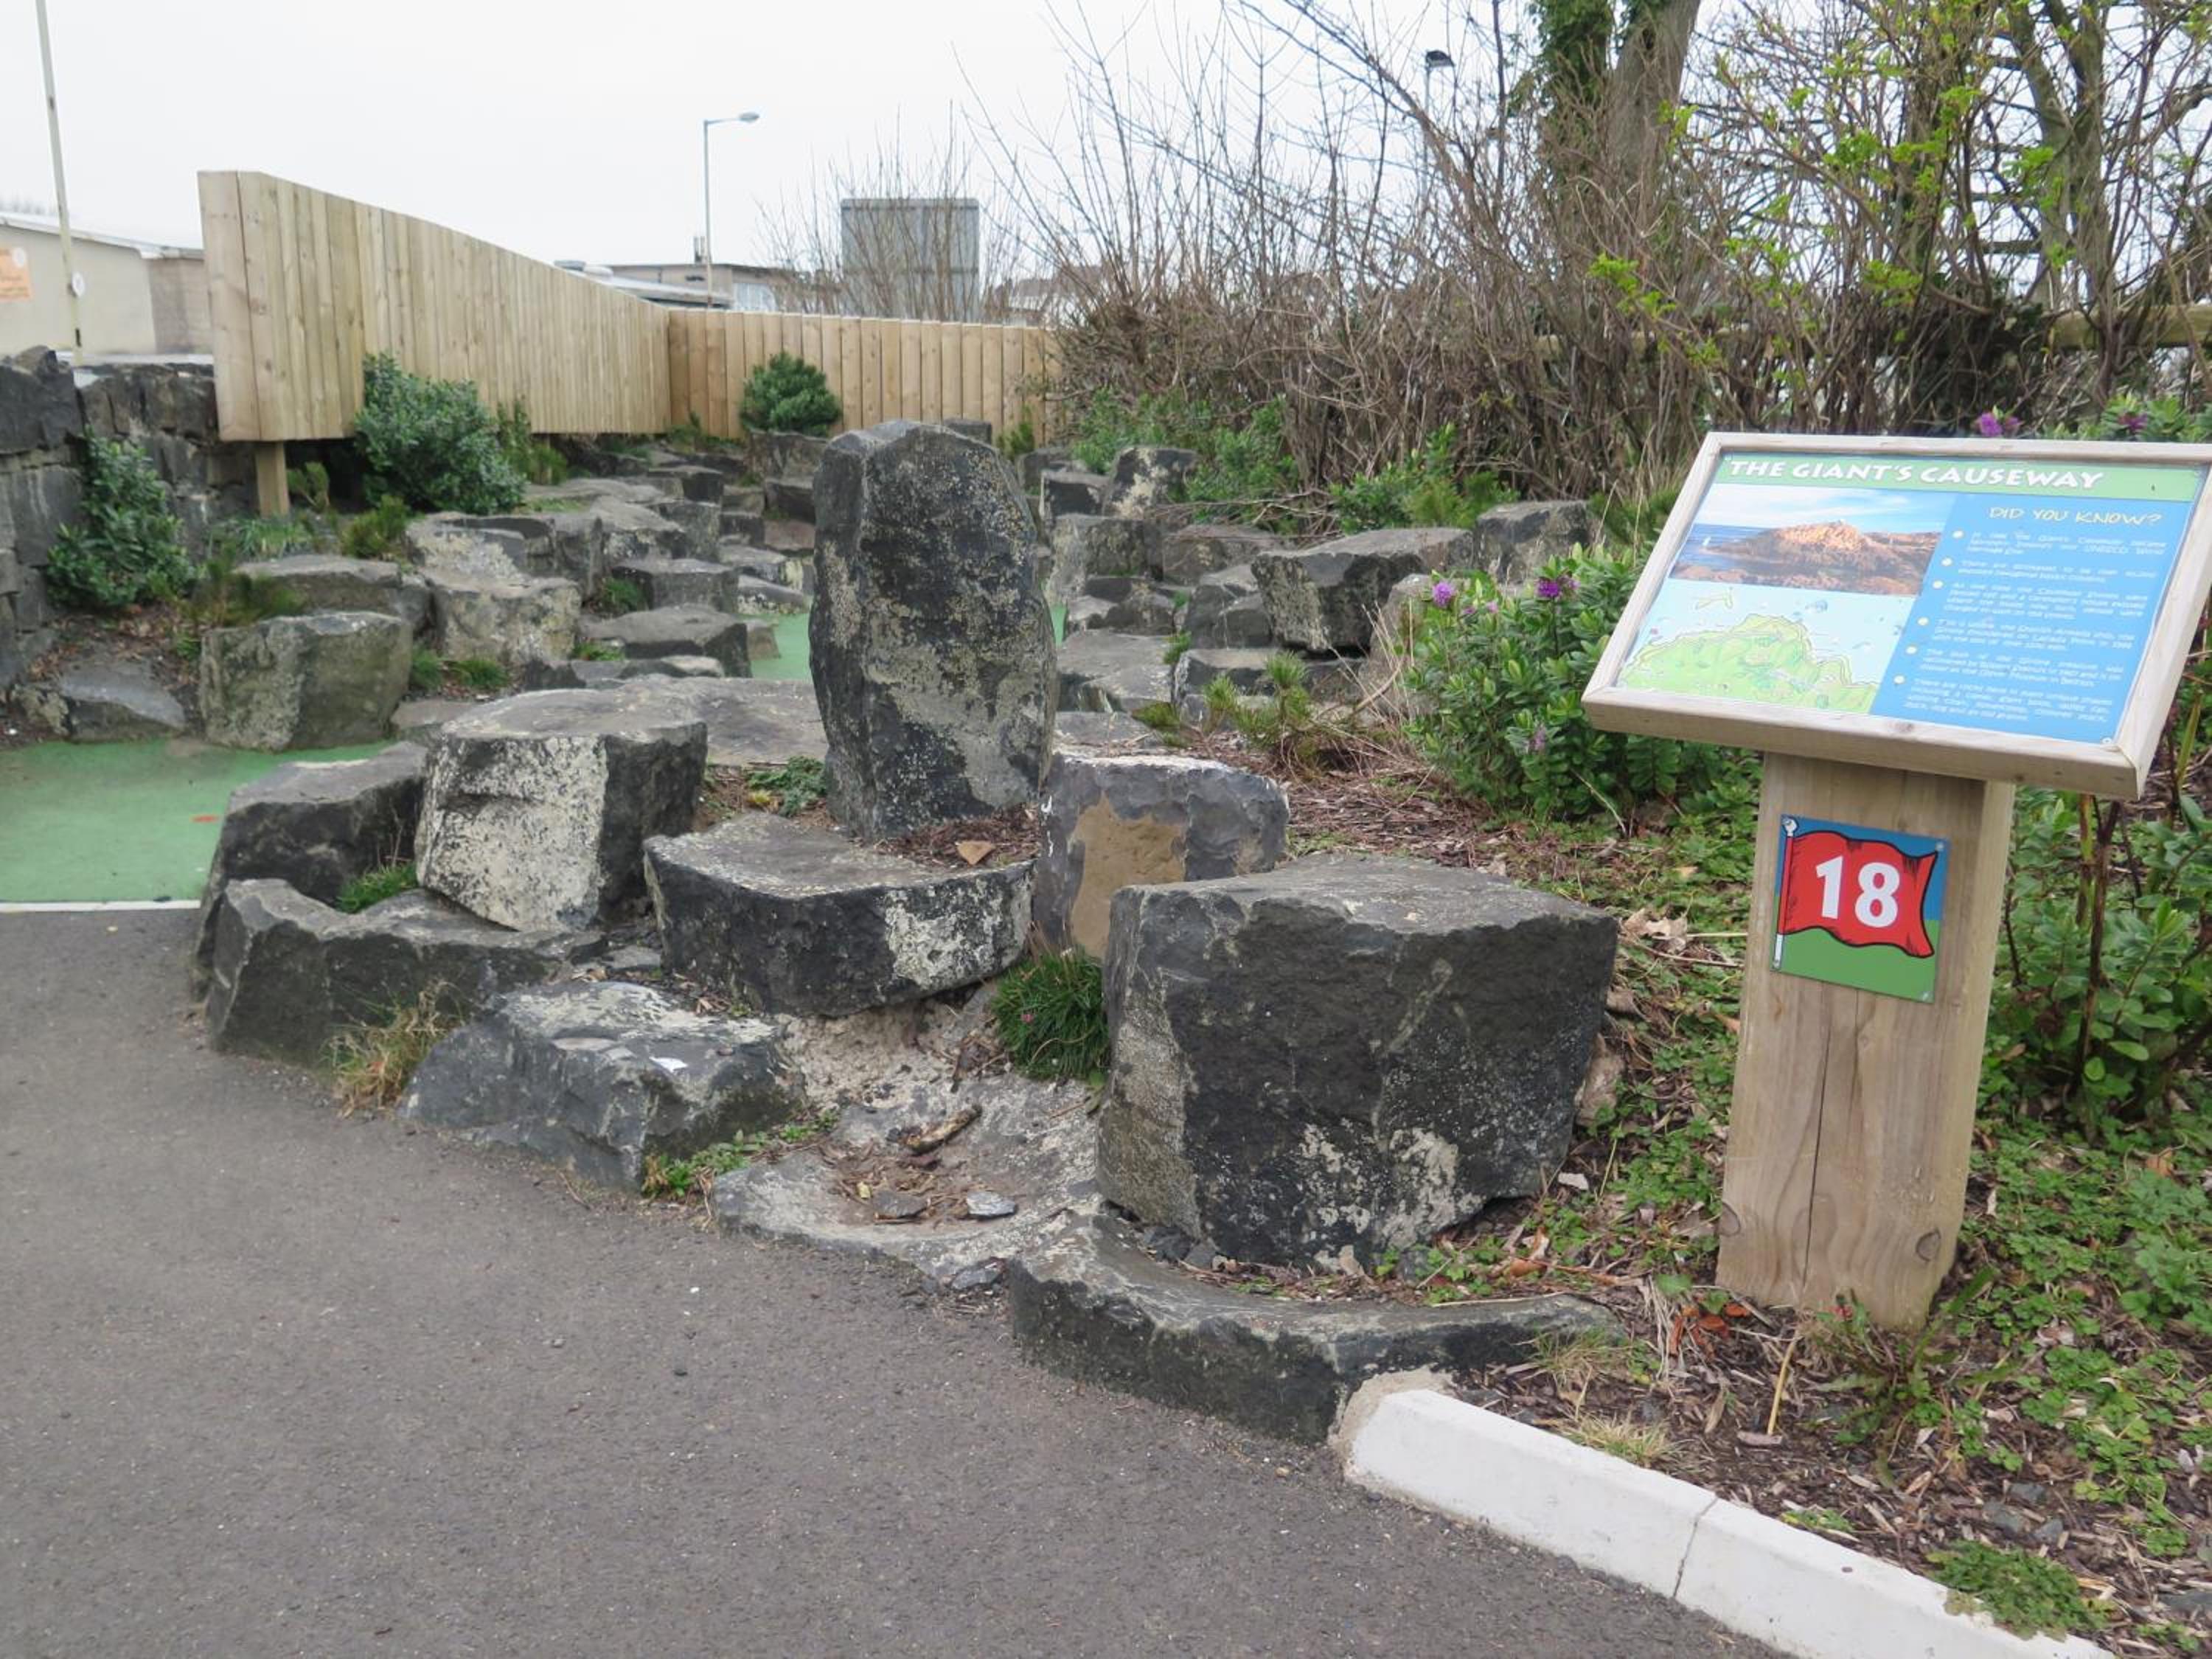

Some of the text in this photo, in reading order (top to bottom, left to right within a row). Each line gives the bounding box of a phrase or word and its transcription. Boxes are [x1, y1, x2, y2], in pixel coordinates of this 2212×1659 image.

[1729, 461, 2104, 489] THE GIANT'S CAUSEWAY
[1989, 507, 2163, 526] DID YOU KNOW?
[1815, 855, 1901, 928] 18
